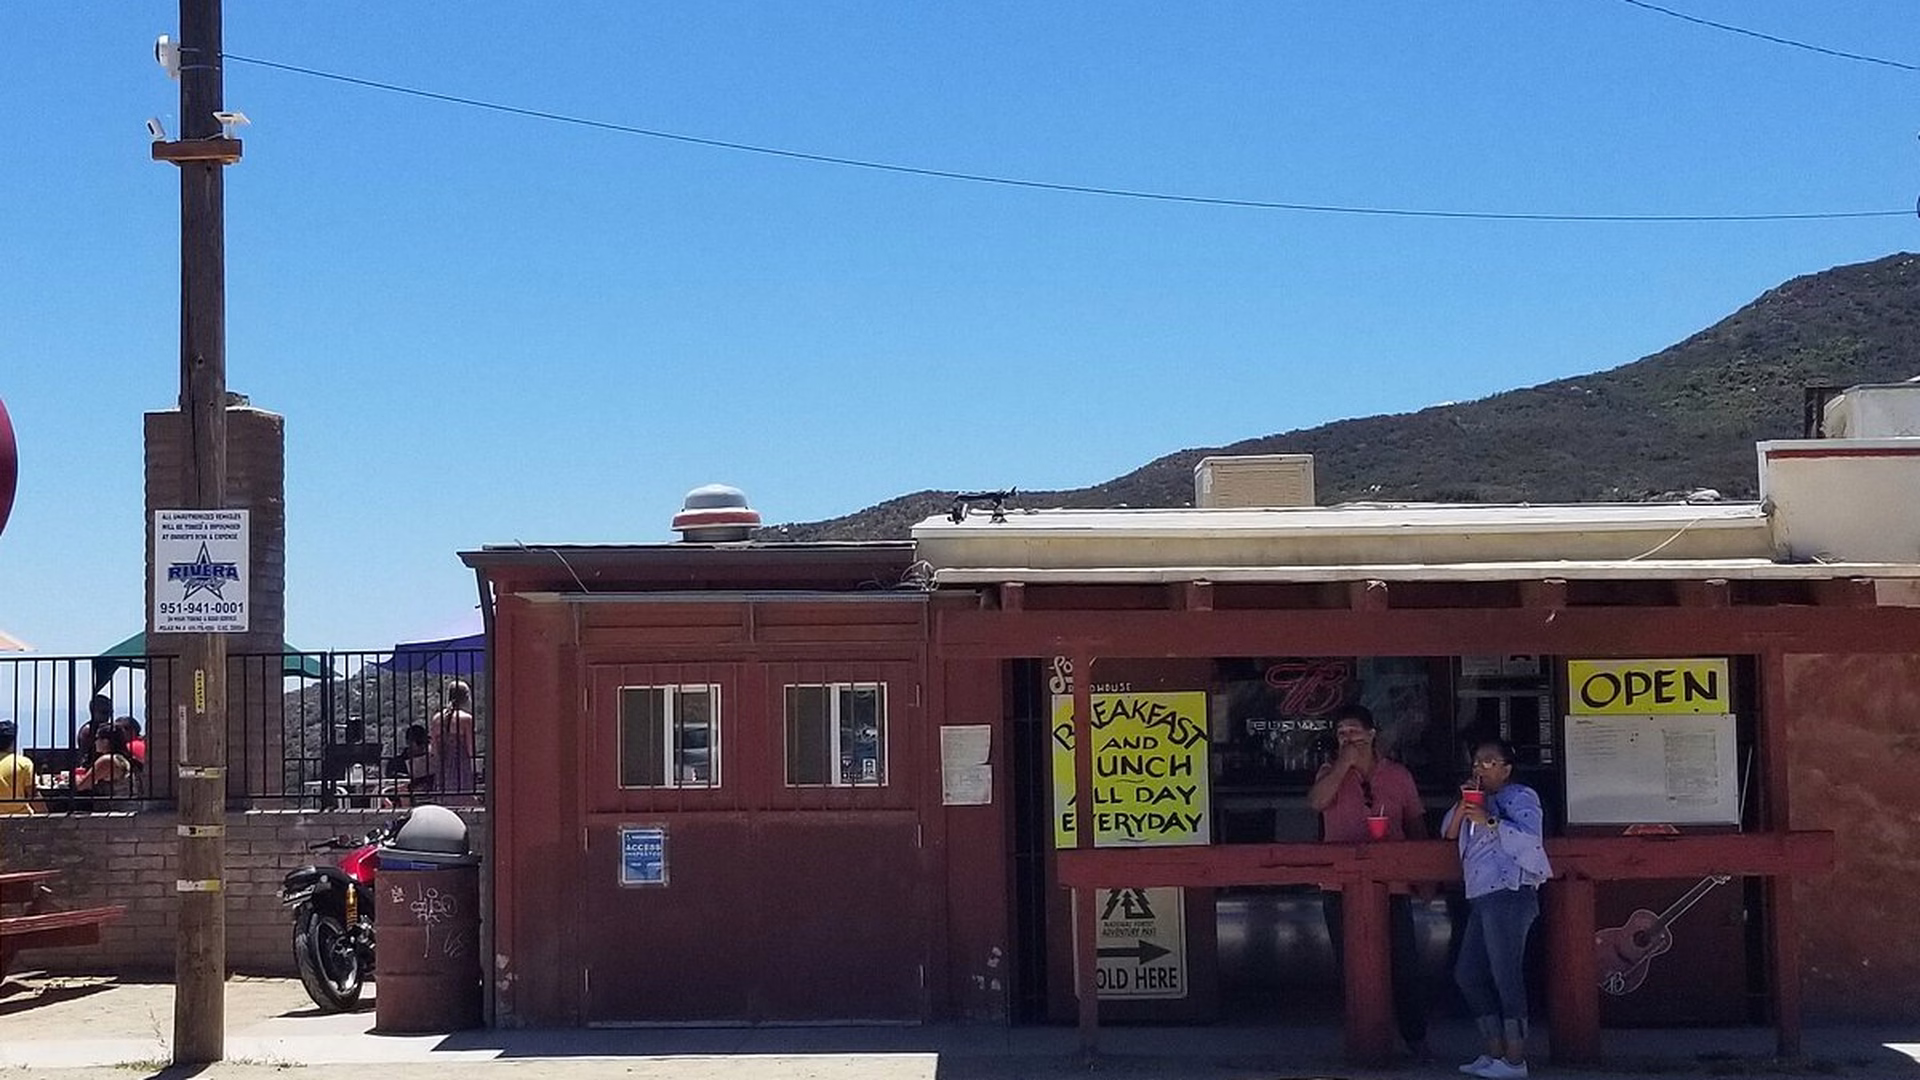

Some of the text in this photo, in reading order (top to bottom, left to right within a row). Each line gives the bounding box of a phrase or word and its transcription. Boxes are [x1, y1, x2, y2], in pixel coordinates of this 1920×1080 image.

[168, 564, 240, 582] RIVERA
[160, 602, 244, 614] 951-941-0001
[1580, 670, 1718, 708] OPEN
[1053, 699, 1209, 751] BEAKFAST
[1100, 736, 1159, 752] AND
[1097, 754, 1192, 778] UNCH
[1068, 785, 1197, 806] LL DAY
[1062, 811, 1203, 838] EERYDAY
[1096, 967, 1178, 990] OLD HERE
